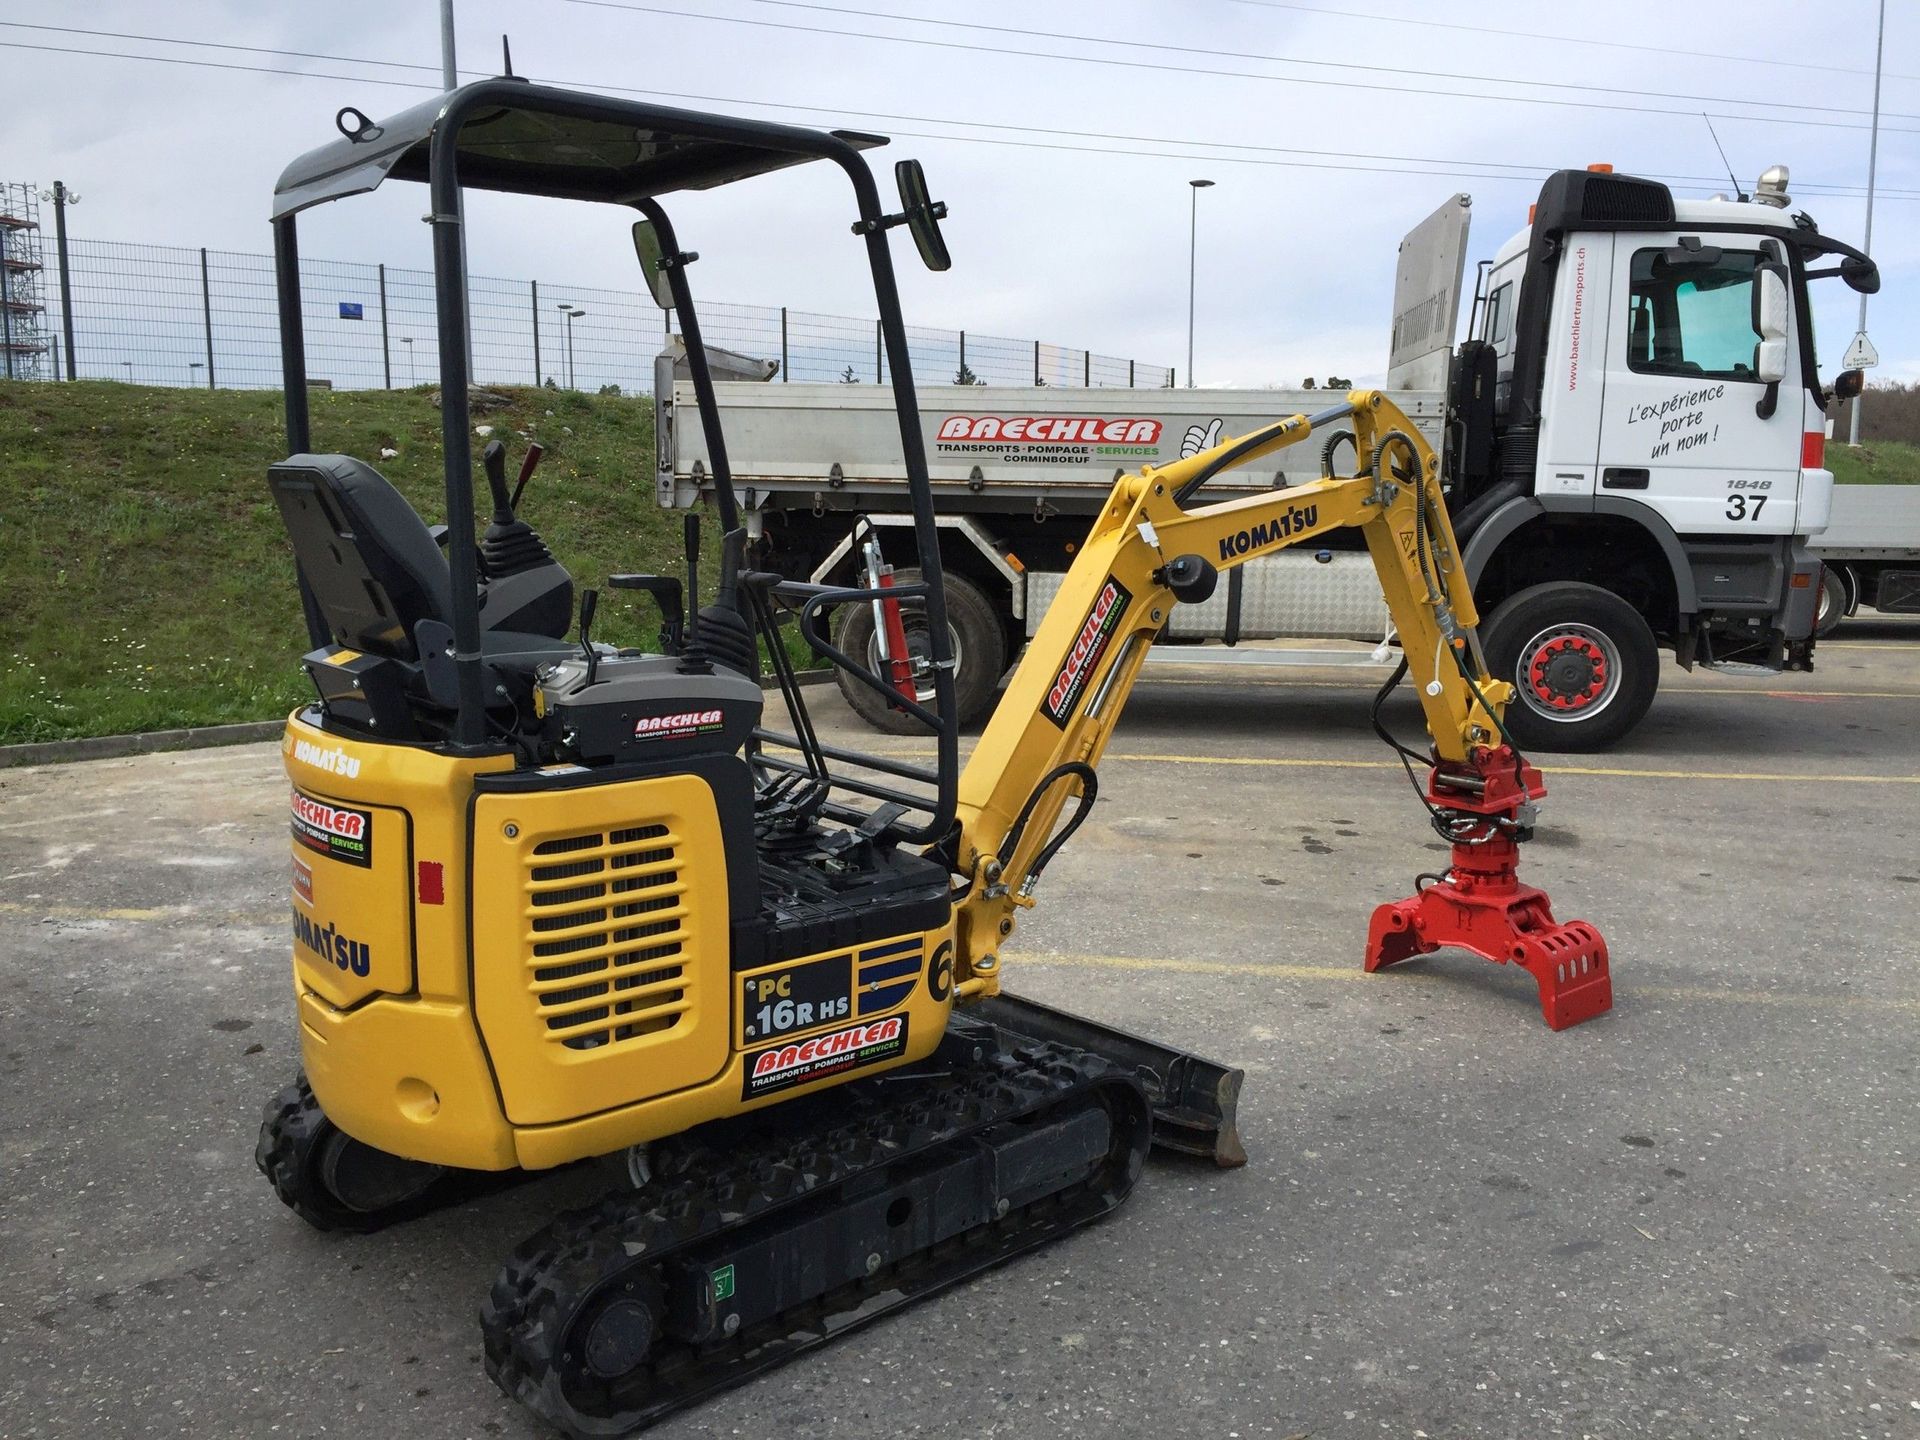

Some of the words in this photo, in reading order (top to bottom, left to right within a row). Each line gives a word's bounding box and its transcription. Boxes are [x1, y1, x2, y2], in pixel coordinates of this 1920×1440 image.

[1569, 247, 1586, 392] www.baechlertransports.ch
[1628, 384, 1725, 424] L'expérience
[939, 416, 1162, 444] BAECHLER
[1660, 411, 1703, 440] porte
[937, 443, 1021, 454] TRANSPORTS
[1027, 445, 1089, 455] POMPAGE
[1096, 446, 1160, 456] SERVICES
[1003, 455, 1091, 464] CORMINBOEUF
[1651, 442, 1670, 459] un
[1676, 431, 1709, 452] nom
[1727, 479, 1773, 490] 1848
[1725, 493, 1769, 522] 37
[1219, 504, 1319, 562] KOMATSU
[1049, 583, 1118, 716] BAECHLER
[1056, 669, 1085, 719] TRANSPORTS
[1083, 632, 1105, 669] POMPAGE
[1103, 594, 1124, 631] SERVICES
[635, 709, 723, 732] BAECHLER
[635, 729, 670, 739] TRANSPORTS
[294, 739, 361, 779] KOMATSU
[330, 835, 364, 852] SERVICES
[293, 905, 371, 978] OMATSU
[928, 939, 954, 1002] 6
[758, 973, 792, 1003] PC
[756, 999, 814, 1035] 16R
[819, 996, 849, 1020] HS
[751, 1065, 811, 1088] TRANSPORTS
[814, 1052, 856, 1070] POMPAGE
[859, 1040, 900, 1057] SERVICES
[752, 1017, 903, 1079] BAECHLER
